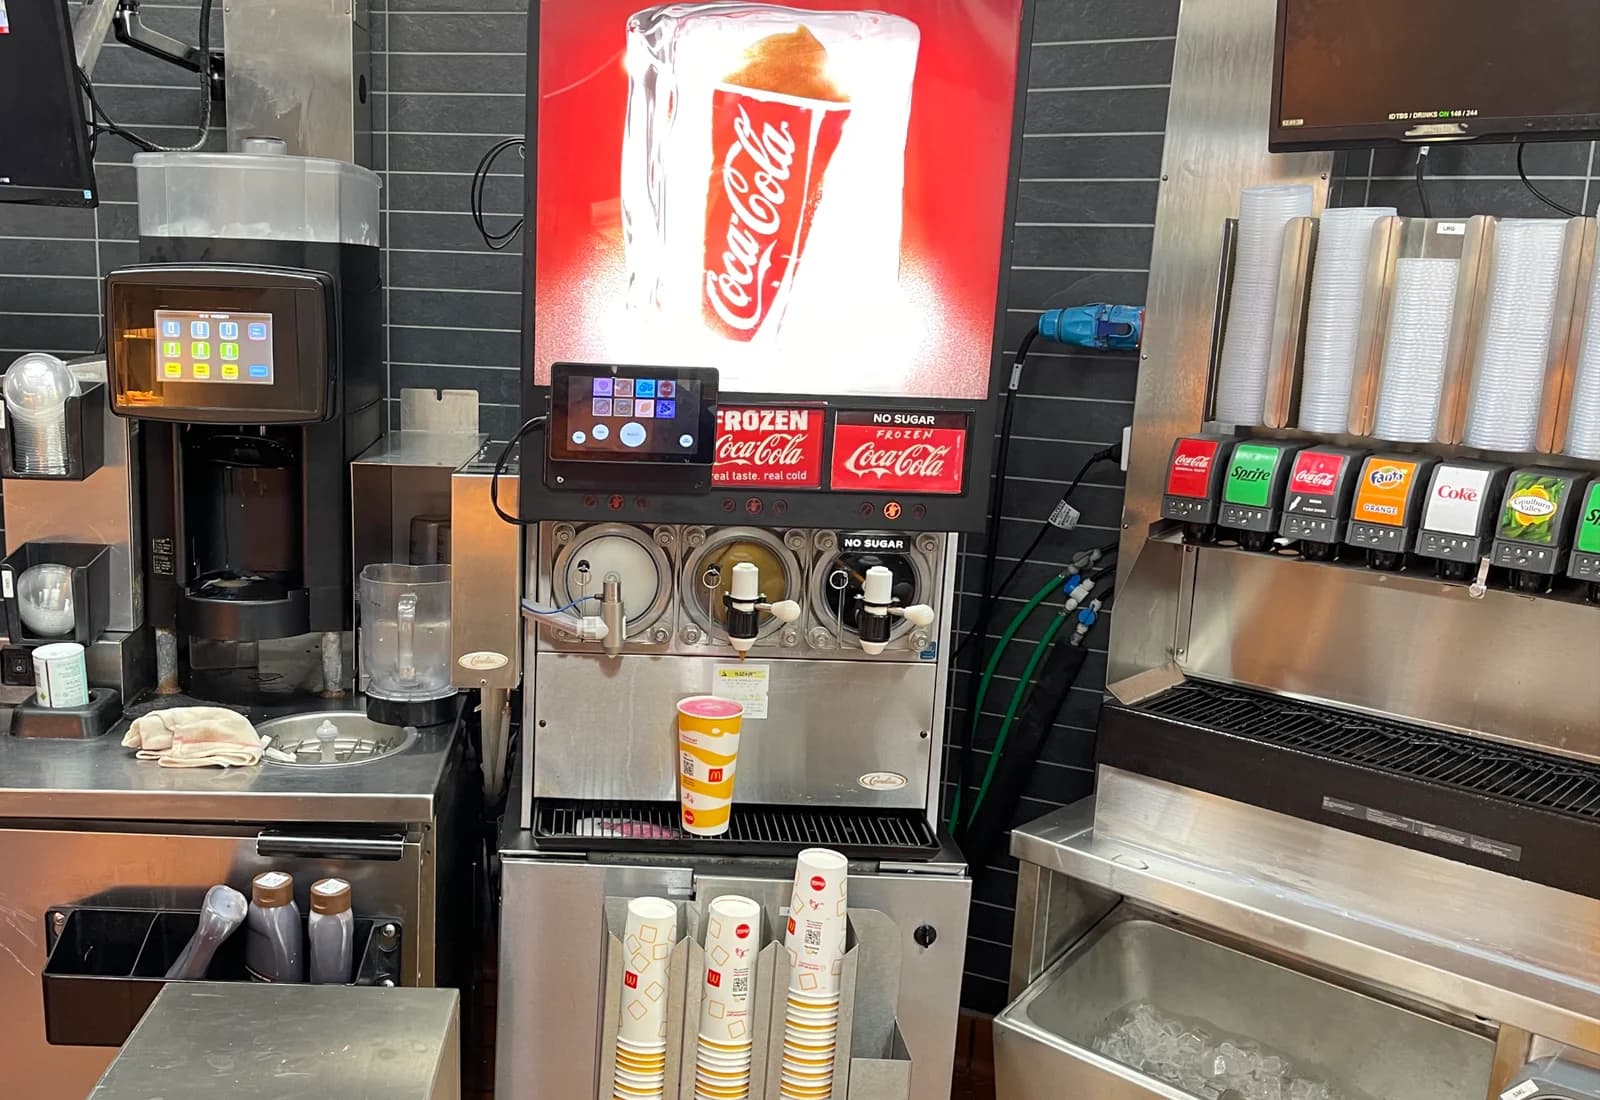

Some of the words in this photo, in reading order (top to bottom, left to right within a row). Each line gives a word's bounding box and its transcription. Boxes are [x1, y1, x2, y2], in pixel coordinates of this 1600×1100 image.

[1413, 111, 1438, 119] DRINKS
[1439, 110, 1449, 118] ON
[706, 104, 796, 330] Coca-Cola
[873, 413, 892, 423] NO
[894, 414, 935, 425] SUGAR
[875, 429, 934, 440] FROZEN
[843, 441, 952, 479] Coca-Cola
[1175, 454, 1210, 468] Coca-Cola
[732, 471, 760, 480] taste.
[764, 471, 783, 480] real
[785, 471, 807, 480] cold
[1231, 465, 1271, 482] Sprite
[1295, 470, 1335, 486] Coca-Cola
[1370, 470, 1403, 485] Fanta
[1437, 484, 1477, 502] Coke
[1363, 503, 1397, 514] ORANGE
[1513, 495, 1551, 511] Goulburn
[844, 539, 861, 547] NO
[864, 539, 904, 549] SUGAR
